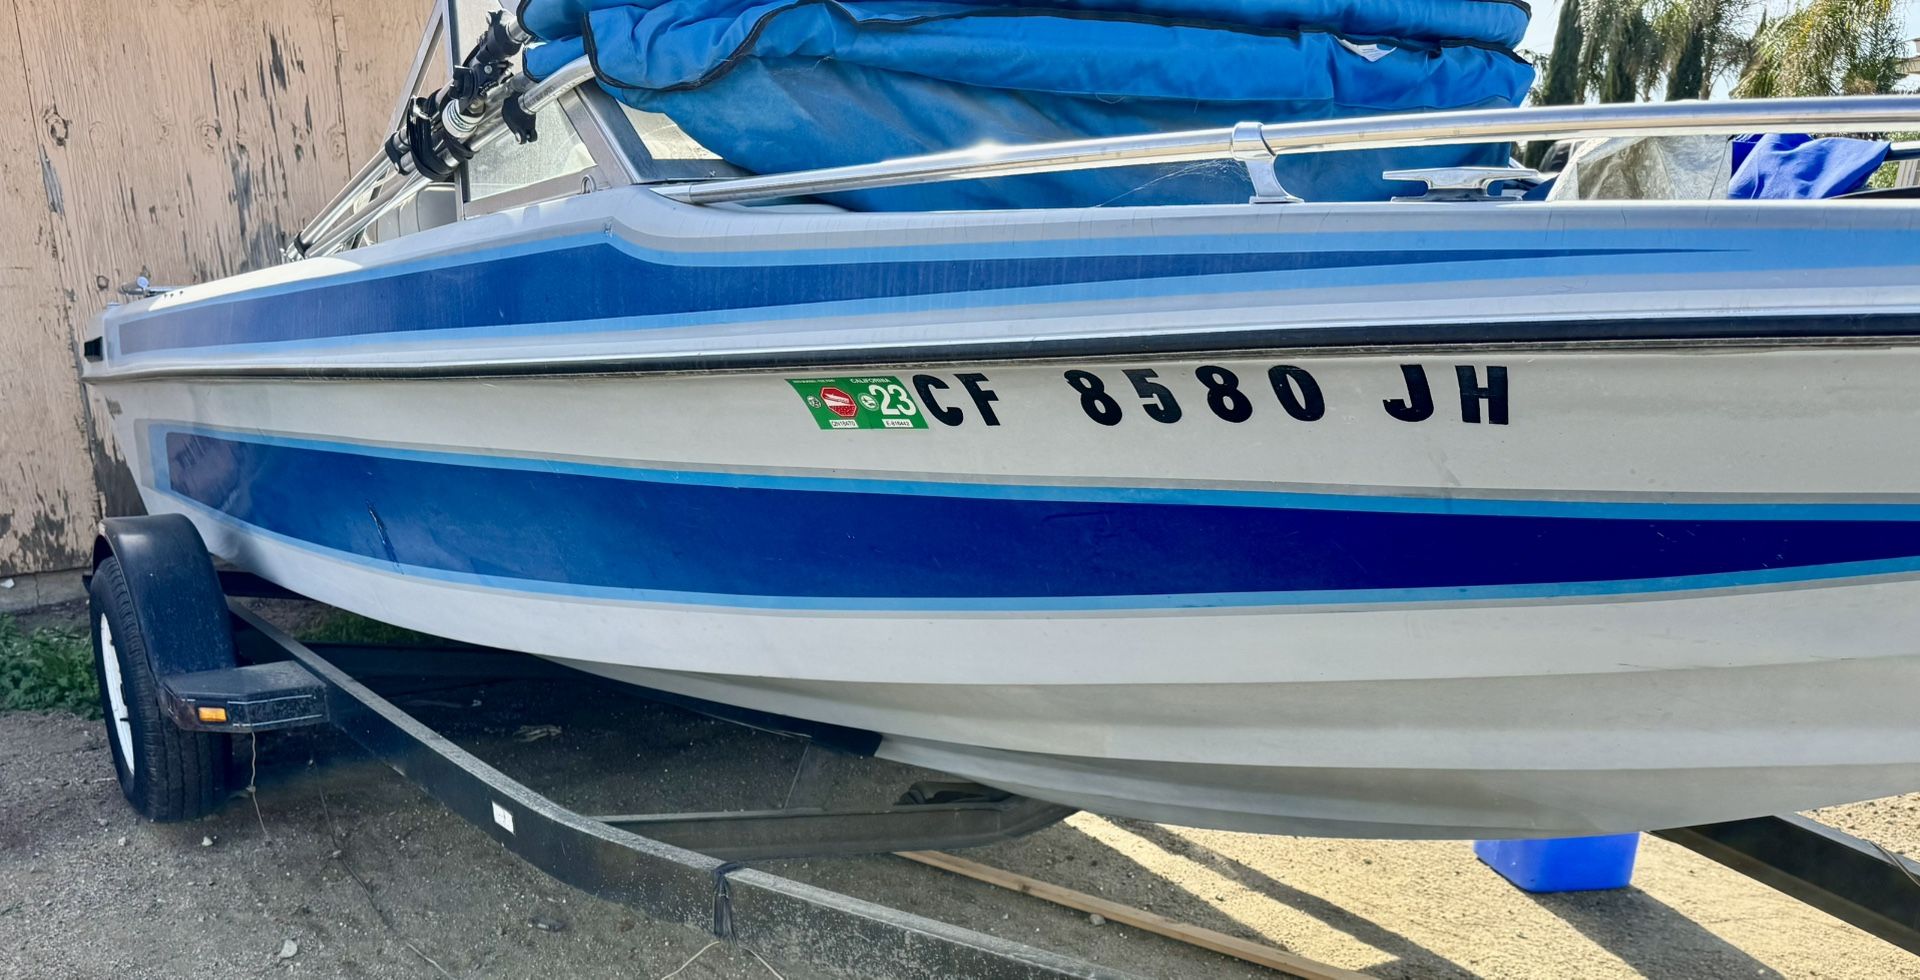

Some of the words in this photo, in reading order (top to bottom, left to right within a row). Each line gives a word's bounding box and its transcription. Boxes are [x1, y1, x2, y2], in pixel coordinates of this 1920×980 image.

[868, 384, 917, 416] 23
[913, 373, 1000, 426] CF
[1064, 365, 1325, 426] 8580
[1383, 364, 1508, 425] JH
